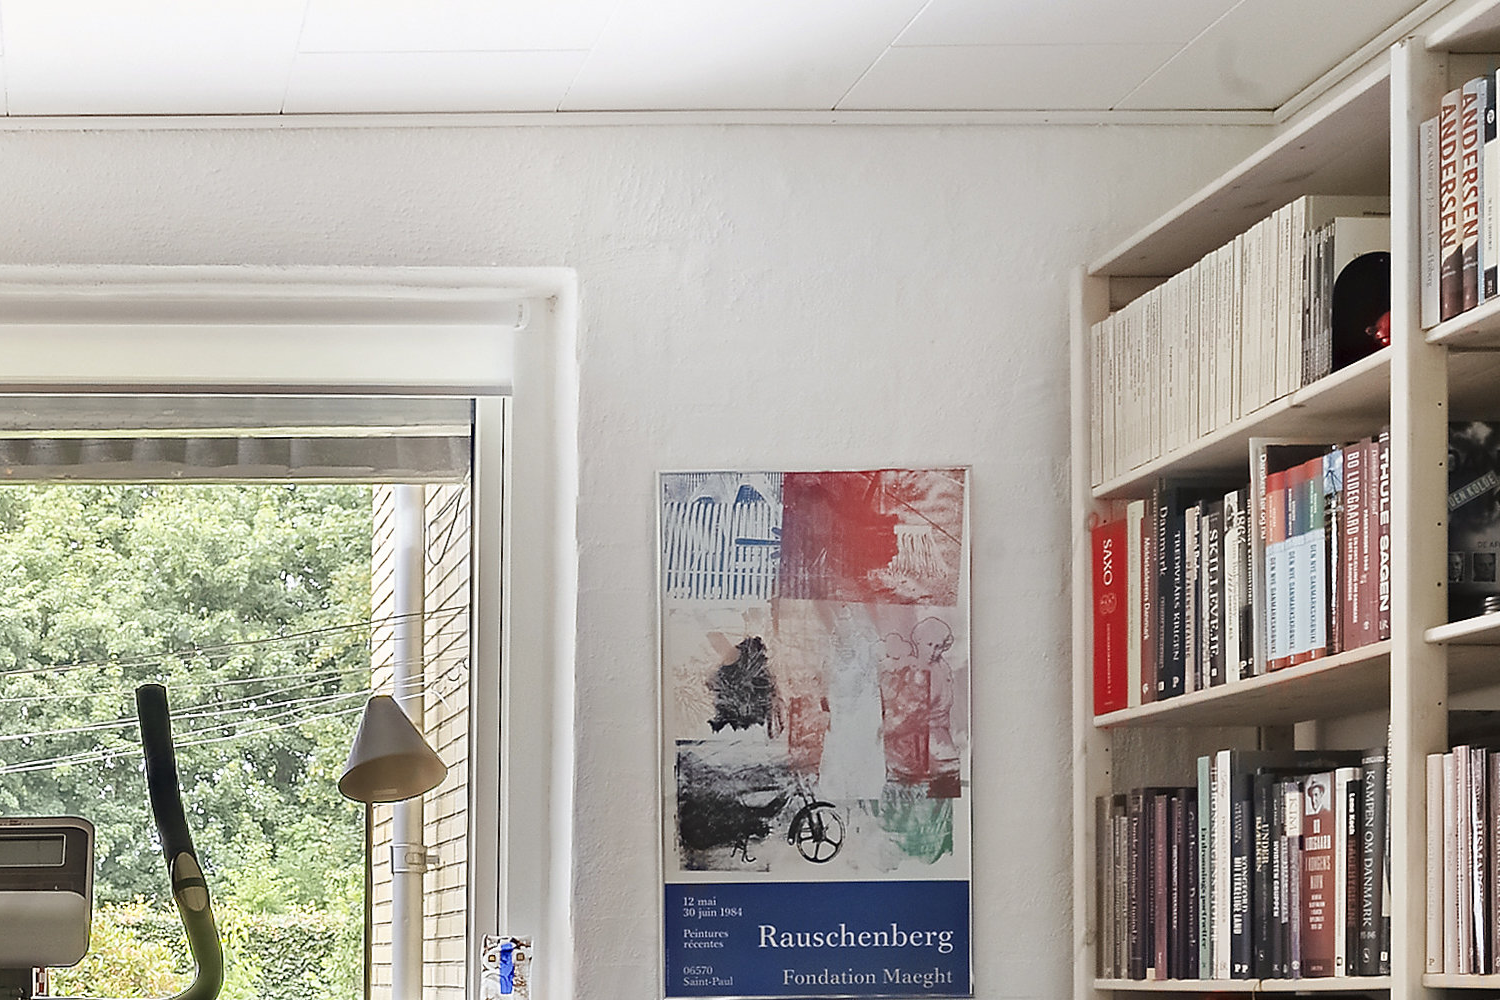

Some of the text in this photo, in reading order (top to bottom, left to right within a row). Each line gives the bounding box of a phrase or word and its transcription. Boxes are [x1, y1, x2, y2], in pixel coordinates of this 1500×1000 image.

[1440, 103, 1457, 248] ANDERSEN
[1462, 92, 1479, 241] ANDERSEN
[1347, 451, 1359, 535] BO LIDEGAARD
[1448, 473, 1495, 508] DEN KOLDE
[1158, 506, 1168, 576] Danmark
[1379, 448, 1389, 612] THULE SAGEN
[1102, 539, 1113, 586] SAXO
[1173, 531, 1182, 609] TREDIVEÅRS
[1209, 529, 1219, 657] SKILLEVEJE
[1288, 798, 1297, 831] KIM
[1362, 770, 1375, 926] KAMPEN OM DANMARK
[683, 897, 717, 907] 12 mai
[683, 908, 743, 919] 30 juin 1984
[683, 929, 729, 939] Peintures
[758, 923, 954, 954] Rauschenberg
[1233, 914, 1241, 935] LAND
[683, 939, 724, 949] récentes
[683, 966, 713, 975] 06570
[683, 976, 733, 987] Saint-Paul
[782, 968, 953, 989] Fondation Maeght
